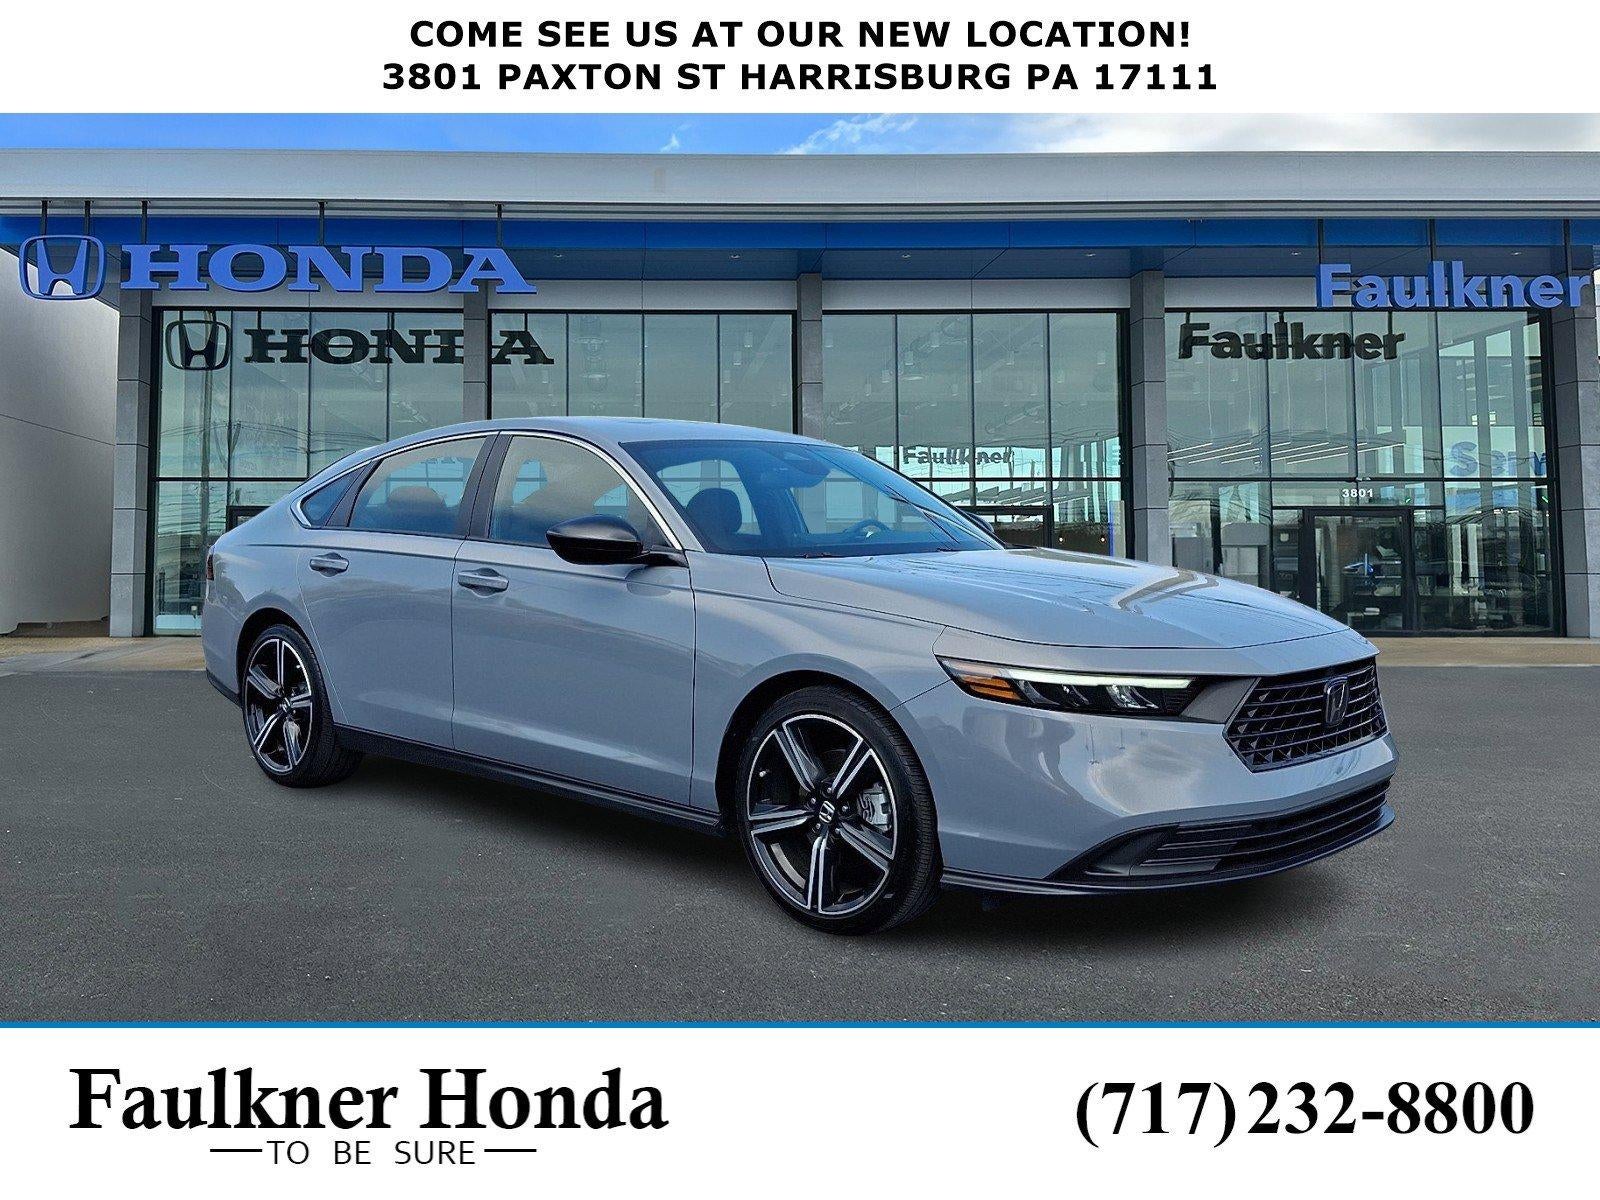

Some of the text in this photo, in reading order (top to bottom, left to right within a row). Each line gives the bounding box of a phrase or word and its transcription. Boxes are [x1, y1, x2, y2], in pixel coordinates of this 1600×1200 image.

[120, 243, 538, 295] HONDA
[1317, 260, 1591, 308] Faulkner
[1178, 322, 1406, 360] Faulkner
[1342, 488, 1373, 498] 3801
